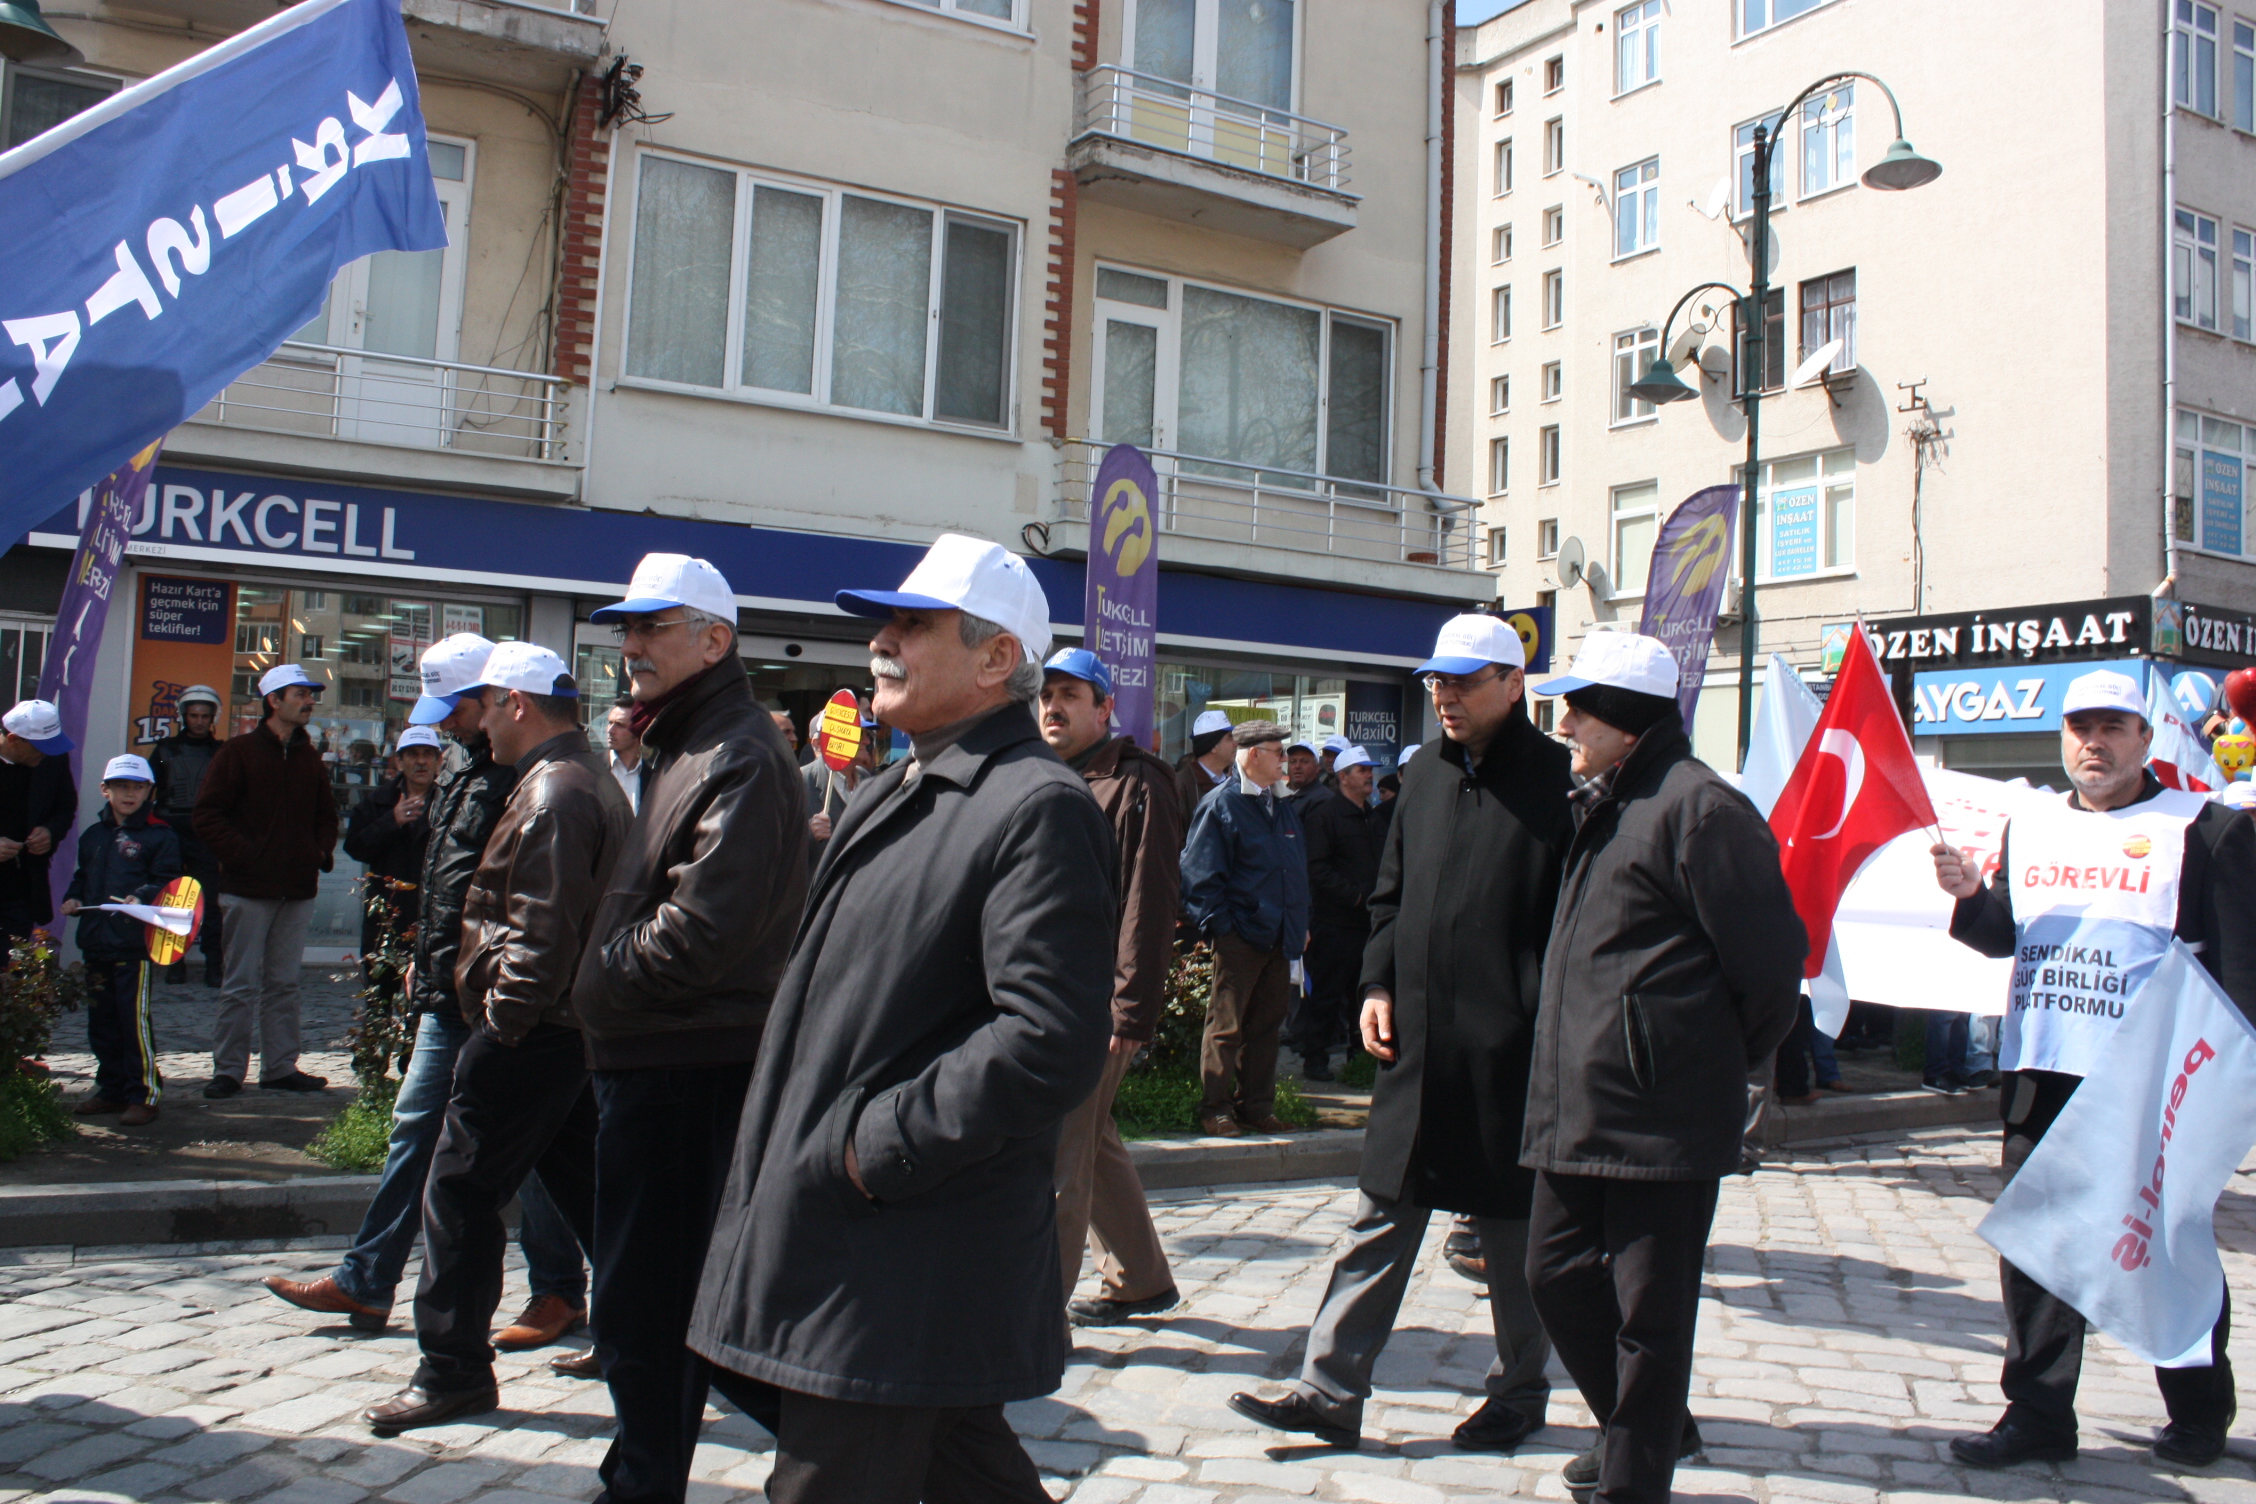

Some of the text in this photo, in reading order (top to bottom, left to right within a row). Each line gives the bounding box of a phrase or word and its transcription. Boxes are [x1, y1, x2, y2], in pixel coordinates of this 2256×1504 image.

[1788, 494, 1815, 508] ÖZEN
[152, 583, 183, 595] Hazır
[149, 610, 183, 623] süper
[150, 598, 219, 611] geçmek için
[149, 623, 201, 636] teklifler!
[1866, 612, 2132, 660] ÖZEN İNŞAAT
[2184, 605, 2241, 654] ÖZEN
[1914, 679, 2045, 722] AYGAZ
[1349, 710, 1397, 723] TURKCELL
[2024, 862, 2151, 894] GÖREVLİ
[2021, 942, 2118, 968] SENDİKAL
[2014, 966, 2128, 996] GÜÇ BİRLİĞİ
[2014, 991, 2125, 1019] PLATFORMU
